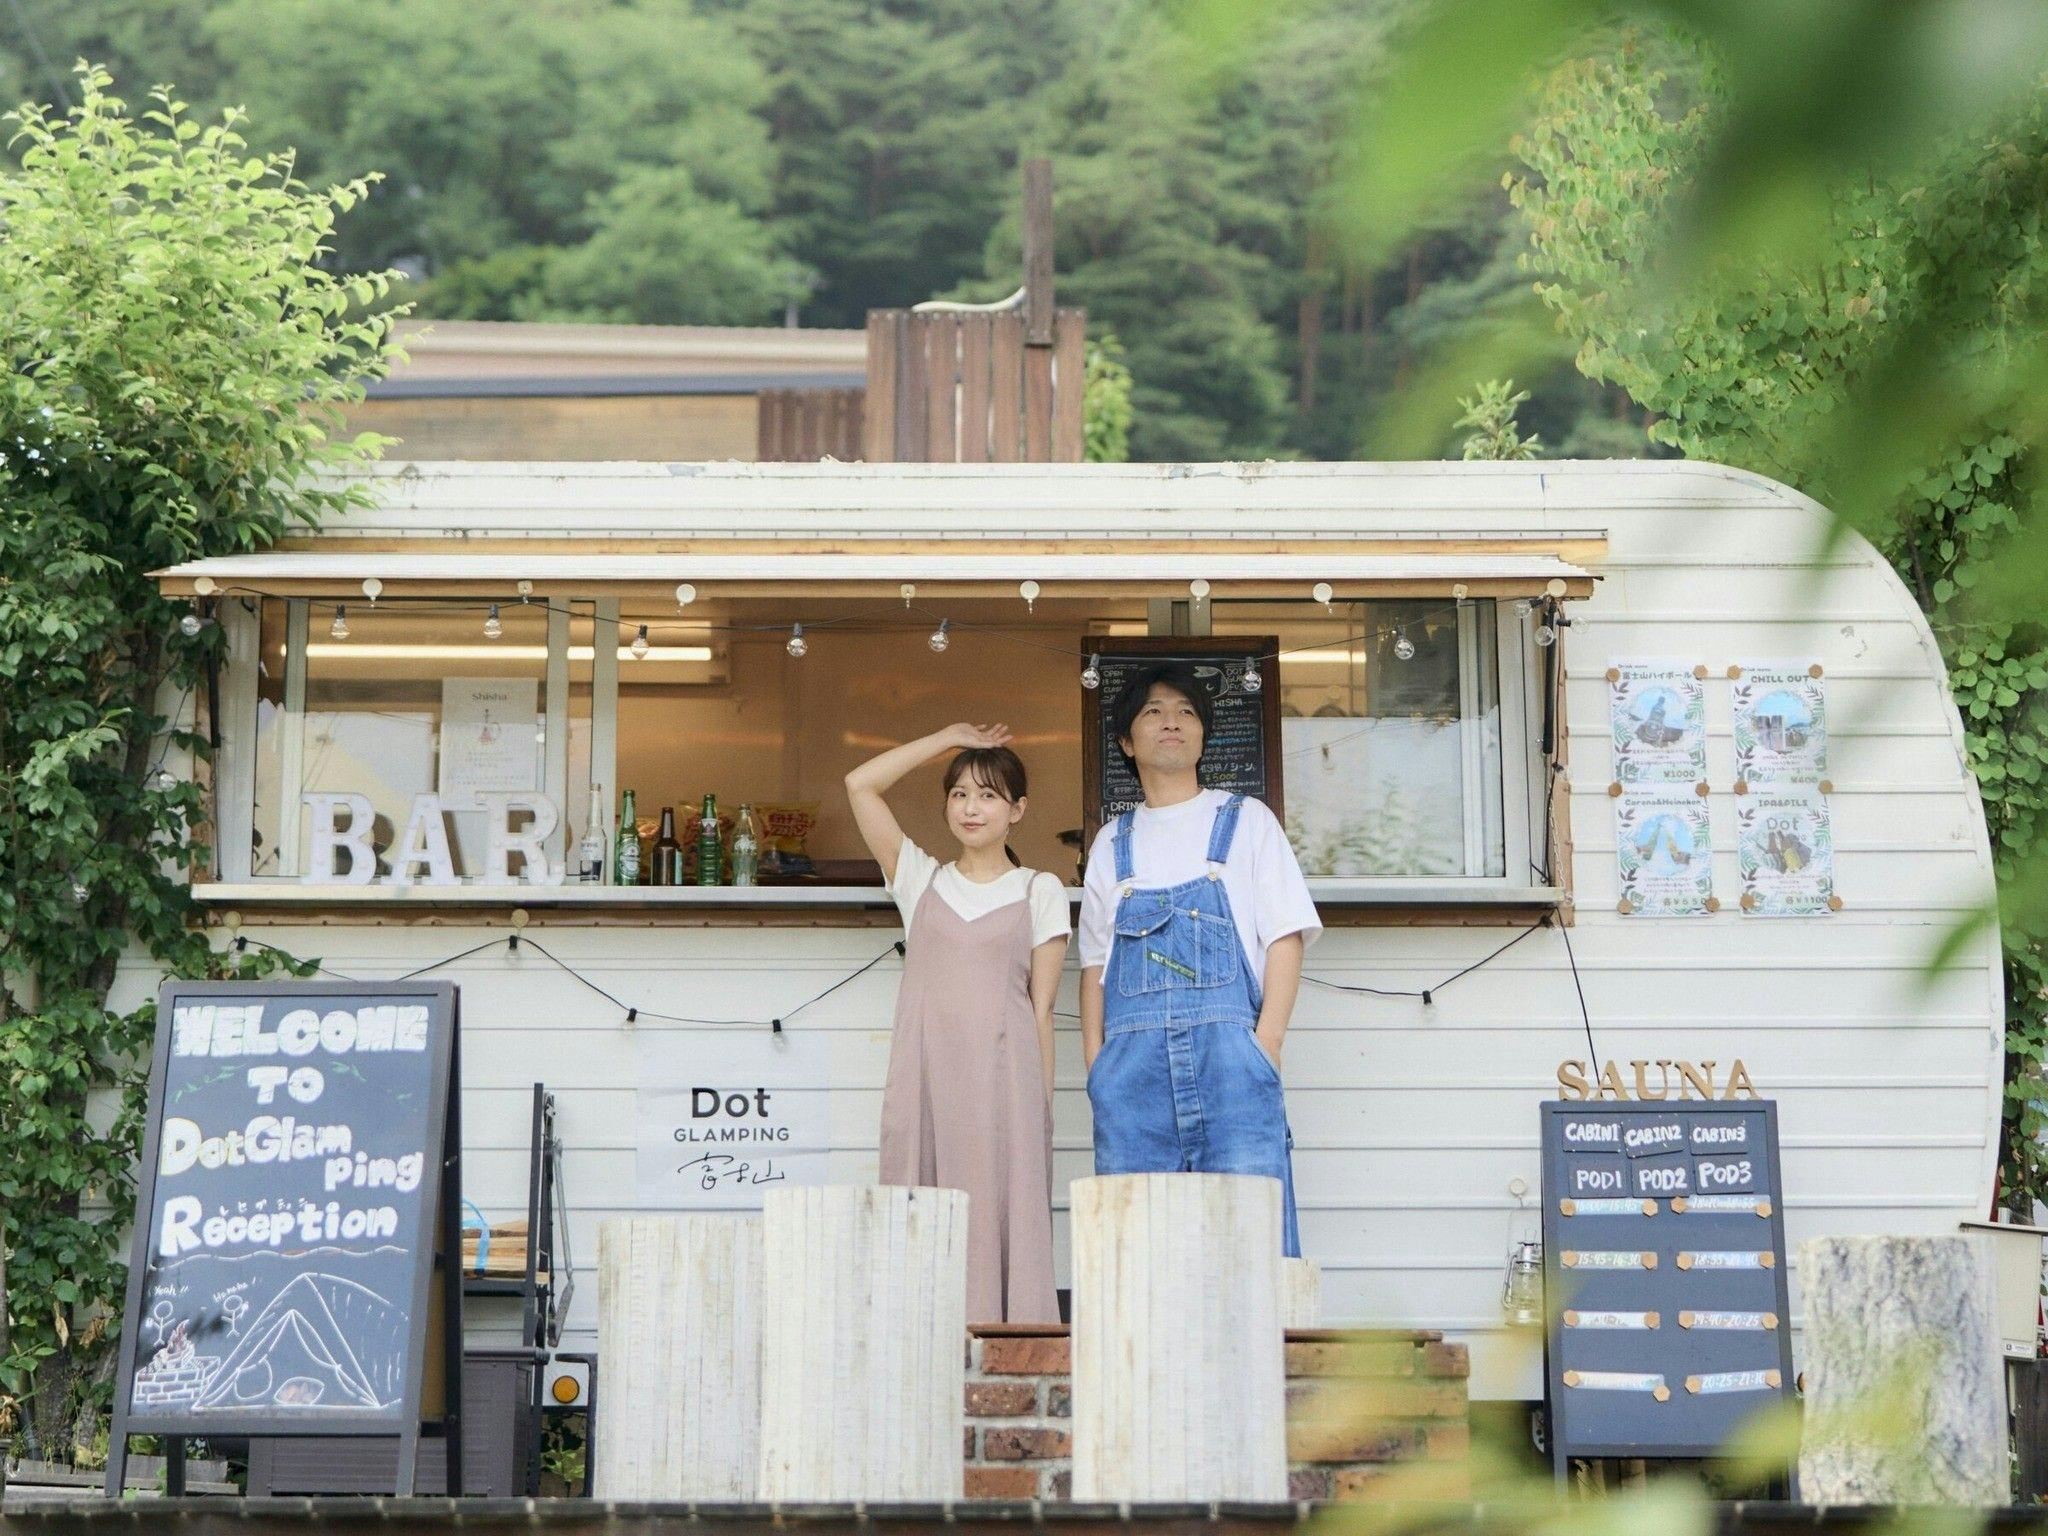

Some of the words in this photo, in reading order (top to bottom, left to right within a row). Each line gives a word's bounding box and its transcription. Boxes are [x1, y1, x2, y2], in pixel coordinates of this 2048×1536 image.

[1751, 675, 1784, 684] CHILL
[1787, 675, 1810, 683] OUT
[299, 792, 566, 886] BAR
[173, 1005, 429, 1057] WELCOME
[247, 1066, 325, 1105] TO
[1557, 1059, 1764, 1101] SAUNA
[691, 1087, 771, 1118] Dot
[673, 1128, 790, 1142] GLAMPING
[1565, 1123, 1619, 1142] CABIN1
[1625, 1124, 1682, 1147] CABIN2
[324, 1151, 424, 1193] ping
[1576, 1170, 1622, 1190] POD1
[1639, 1168, 1688, 1190] POD2
[159, 1195, 398, 1257] Reception
